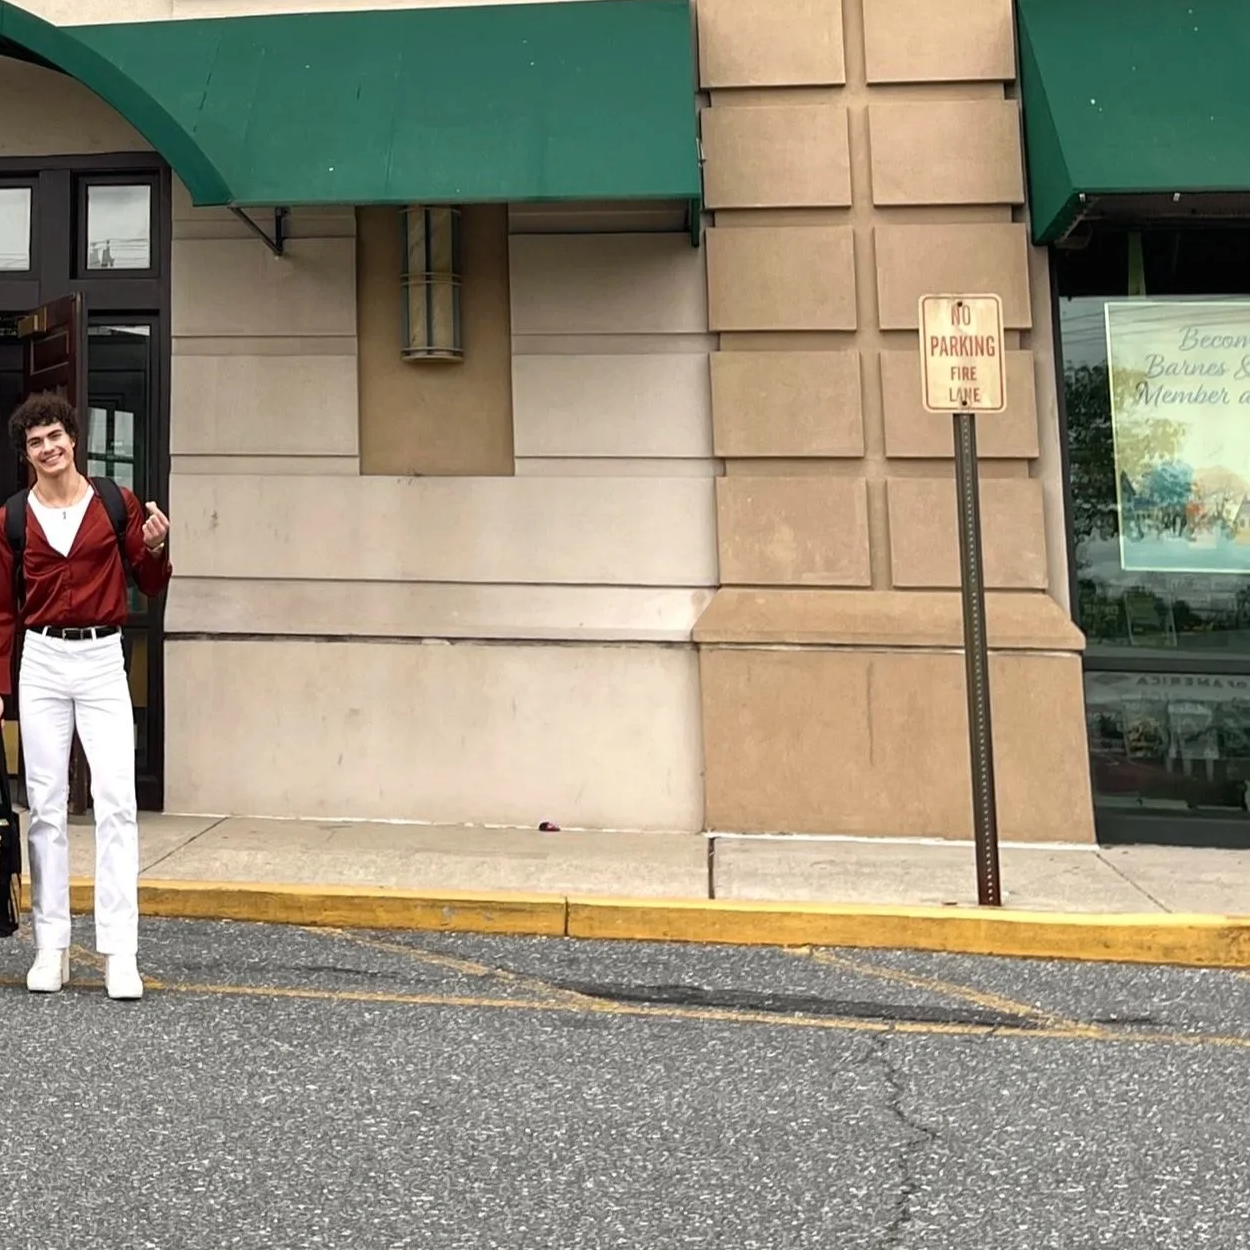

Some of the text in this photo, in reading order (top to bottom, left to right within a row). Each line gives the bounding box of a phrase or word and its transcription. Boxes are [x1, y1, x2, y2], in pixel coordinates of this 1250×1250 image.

[951, 304, 971, 326] NO
[930, 335, 995, 357] PARKING
[950, 366, 977, 381] FIRE
[1145, 354, 1226, 379] Barnes
[949, 387, 981, 403] LANE
[1134, 380, 1230, 408] Member
